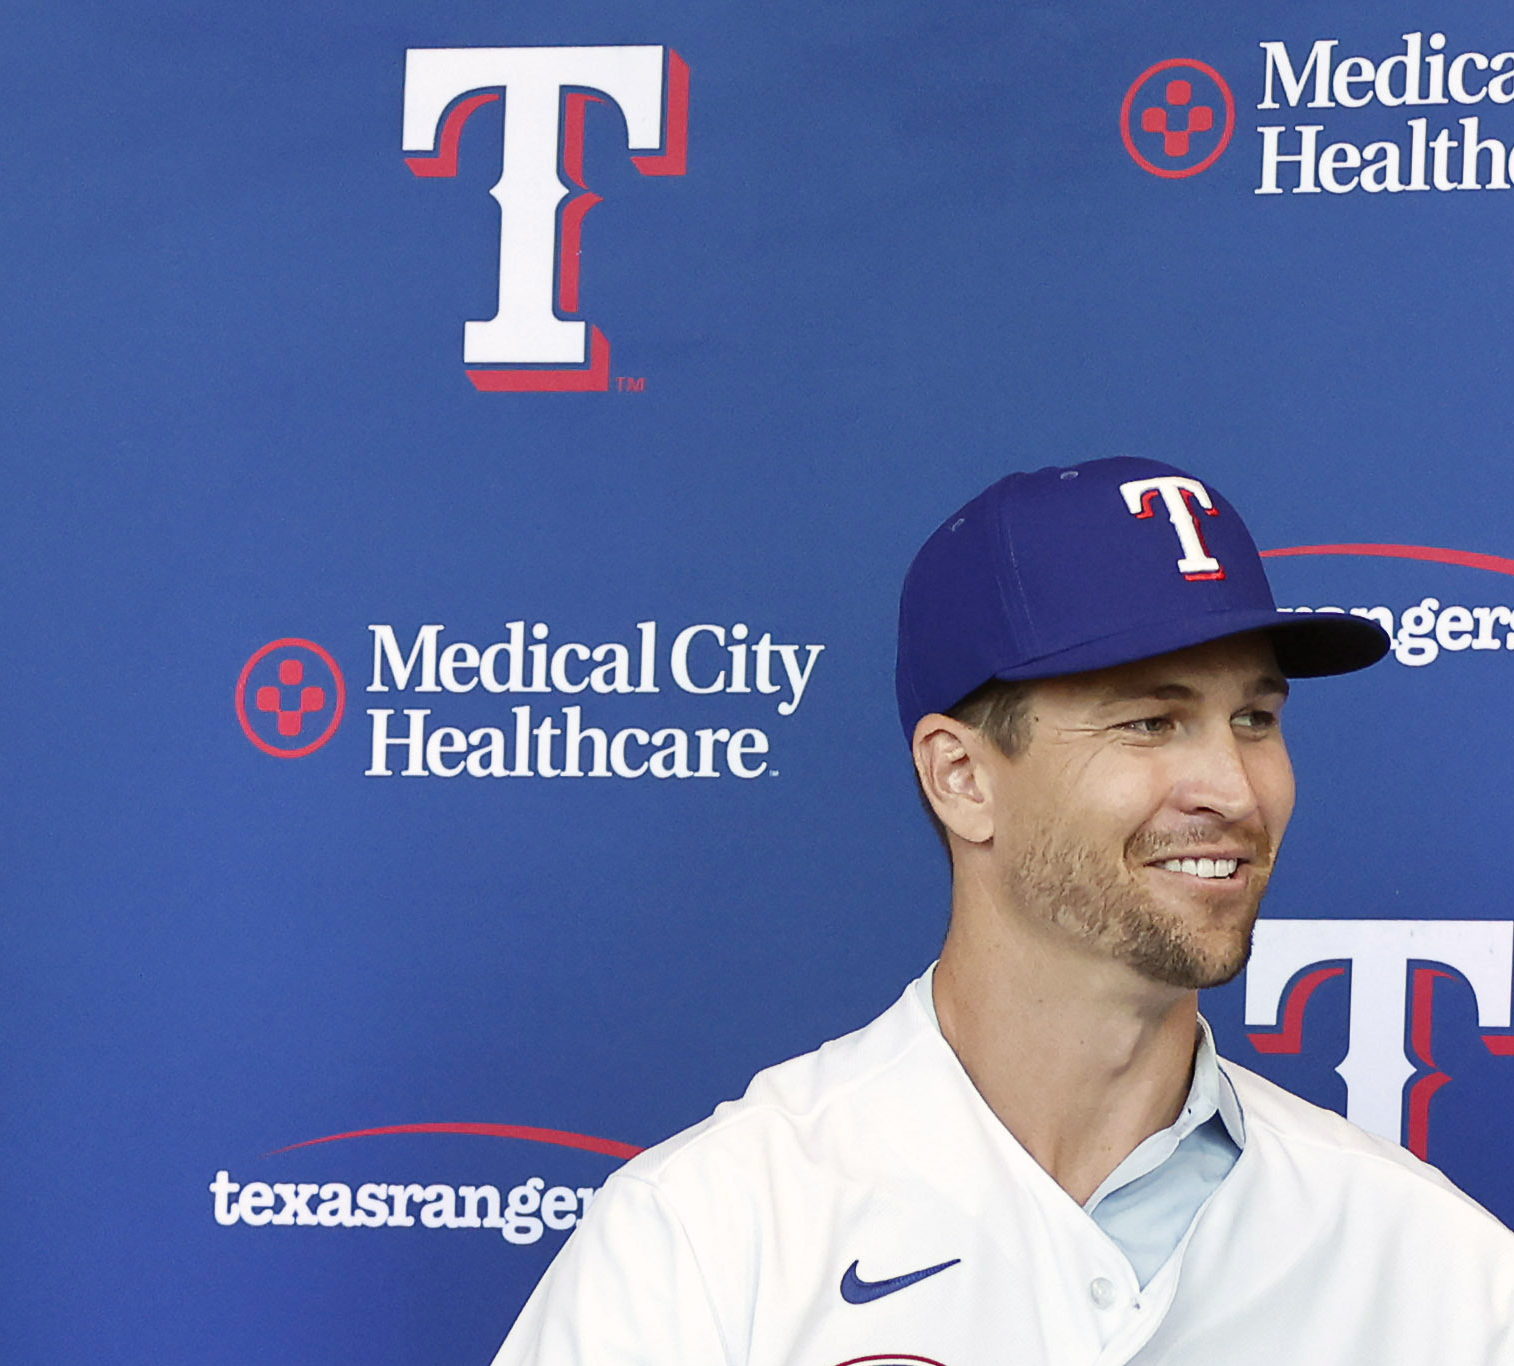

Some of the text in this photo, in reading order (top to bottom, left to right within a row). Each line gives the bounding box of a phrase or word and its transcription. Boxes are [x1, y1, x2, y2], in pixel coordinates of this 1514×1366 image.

[401, 45, 691, 393] T
[1119, 475, 1228, 582] T
[366, 620, 826, 716] Medical City
[364, 705, 769, 779] Healthcare
